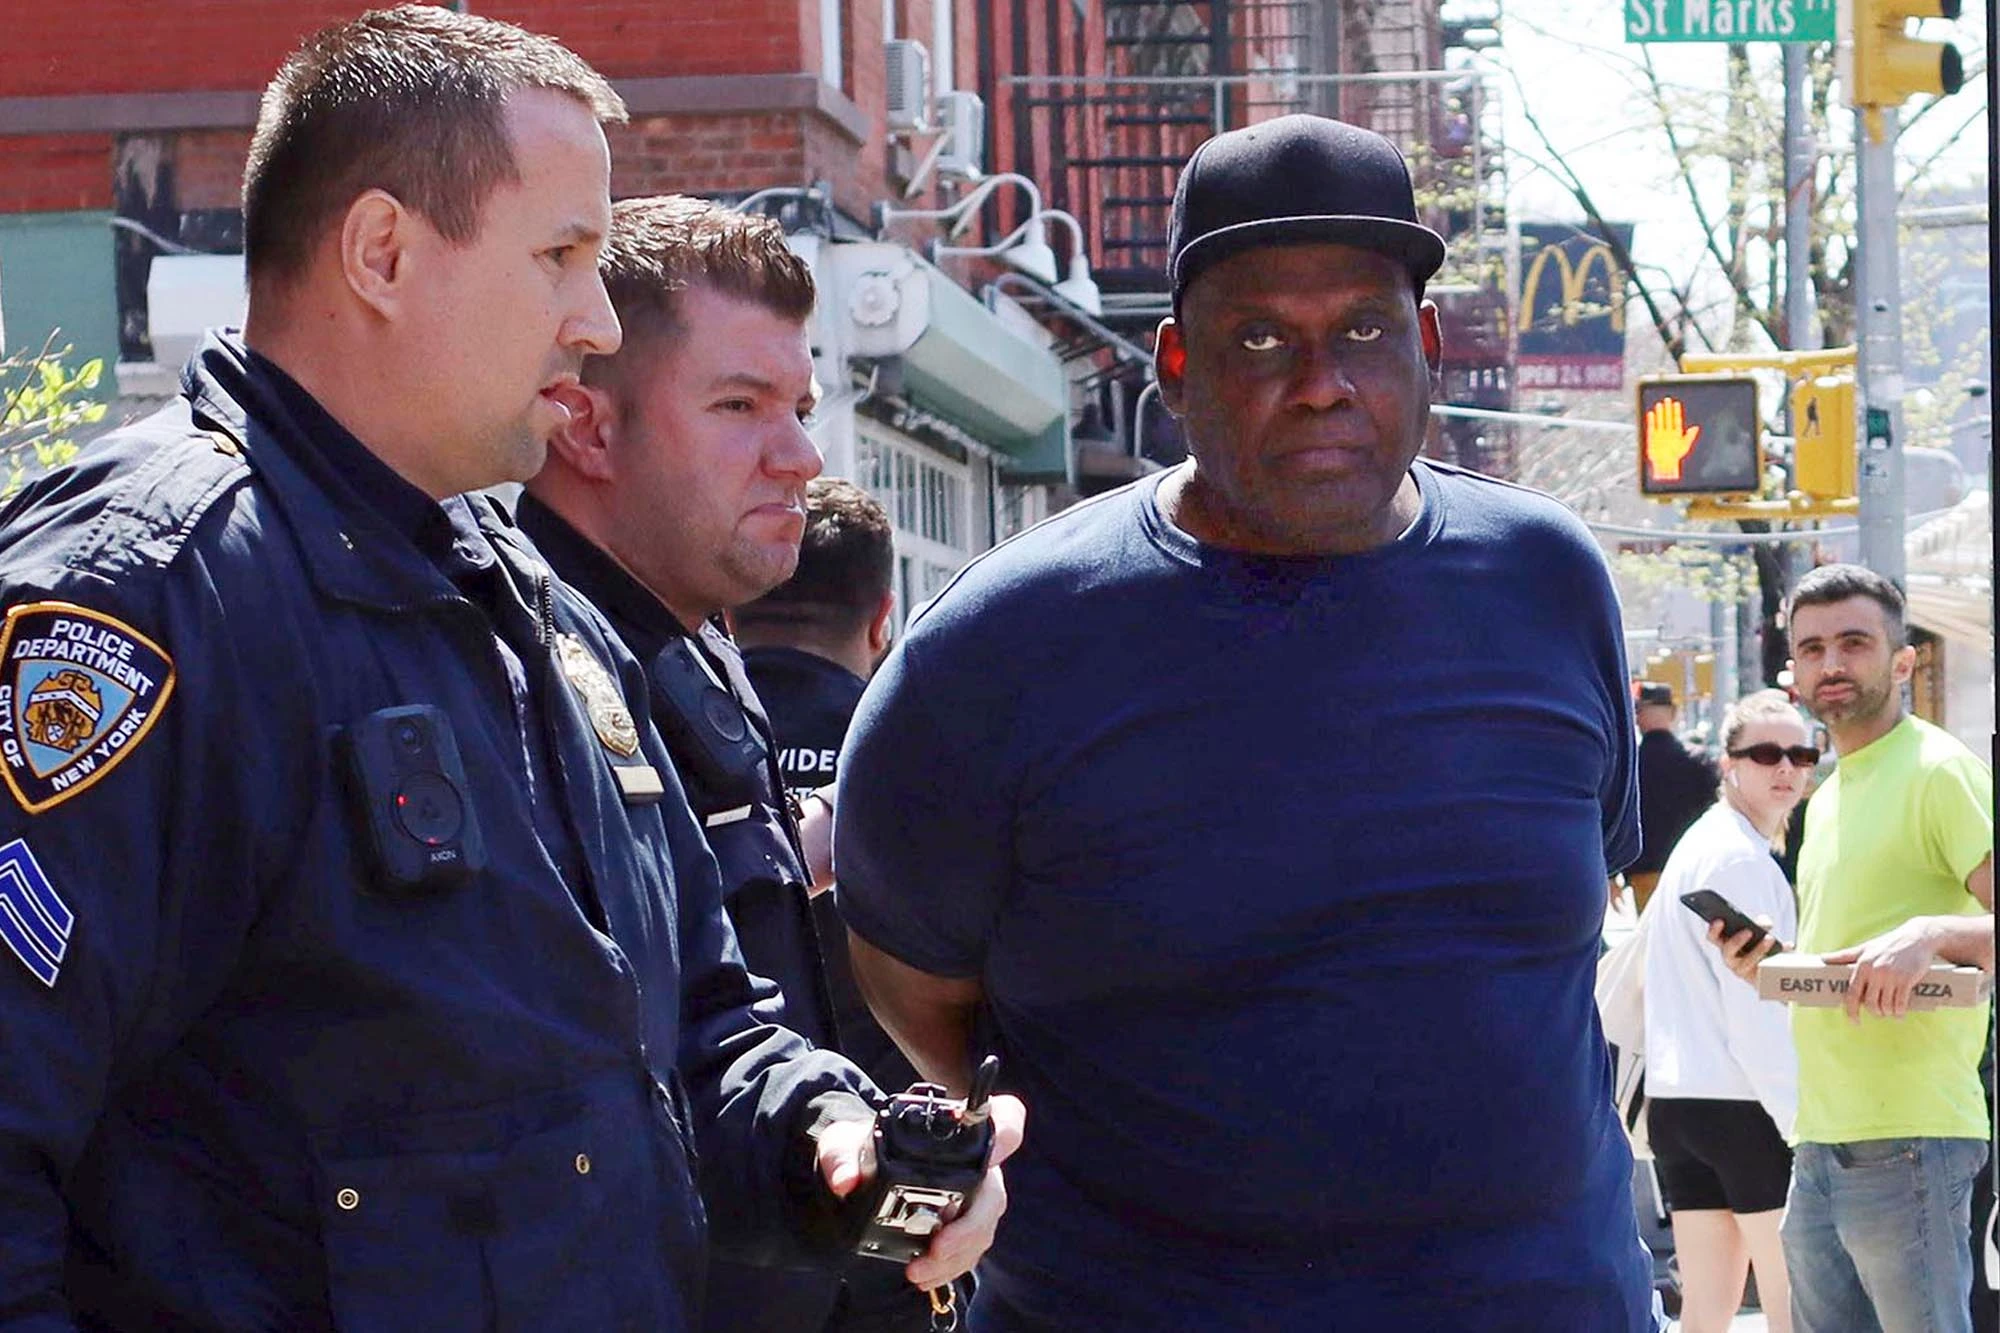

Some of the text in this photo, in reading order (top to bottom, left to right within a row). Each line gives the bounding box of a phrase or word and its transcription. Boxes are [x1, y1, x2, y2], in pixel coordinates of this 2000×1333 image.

[1628, 0, 1796, 35] St Marks
[49, 619, 136, 662] POLICE
[12, 638, 156, 698] DEPARTMENT
[0, 684, 26, 768] CITY OF
[51, 707, 148, 792] NEW YORK
[1779, 977, 1825, 993] EAST
[1911, 982, 1954, 998] IZZA
